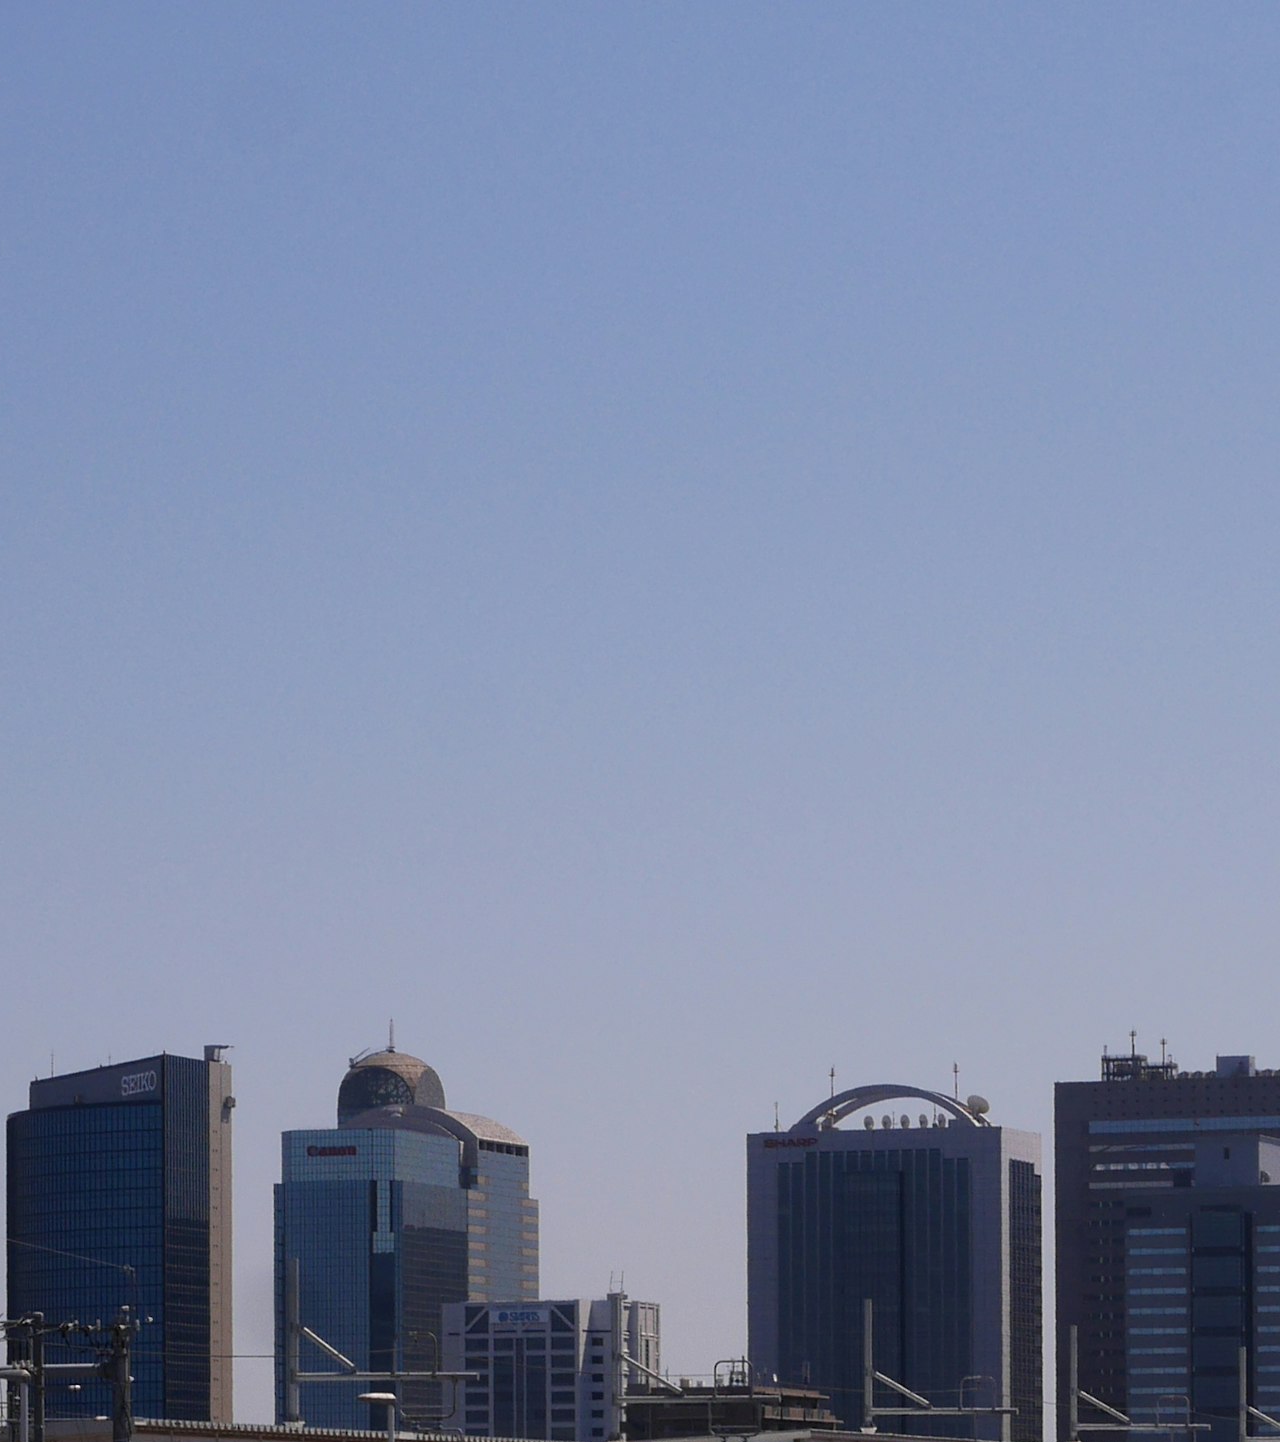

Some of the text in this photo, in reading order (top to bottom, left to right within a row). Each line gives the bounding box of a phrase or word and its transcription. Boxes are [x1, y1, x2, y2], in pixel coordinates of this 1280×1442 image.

[121, 1070, 157, 1096] SEIKO
[764, 1137, 818, 1148] SHARP
[307, 1145, 356, 1156] Canon
